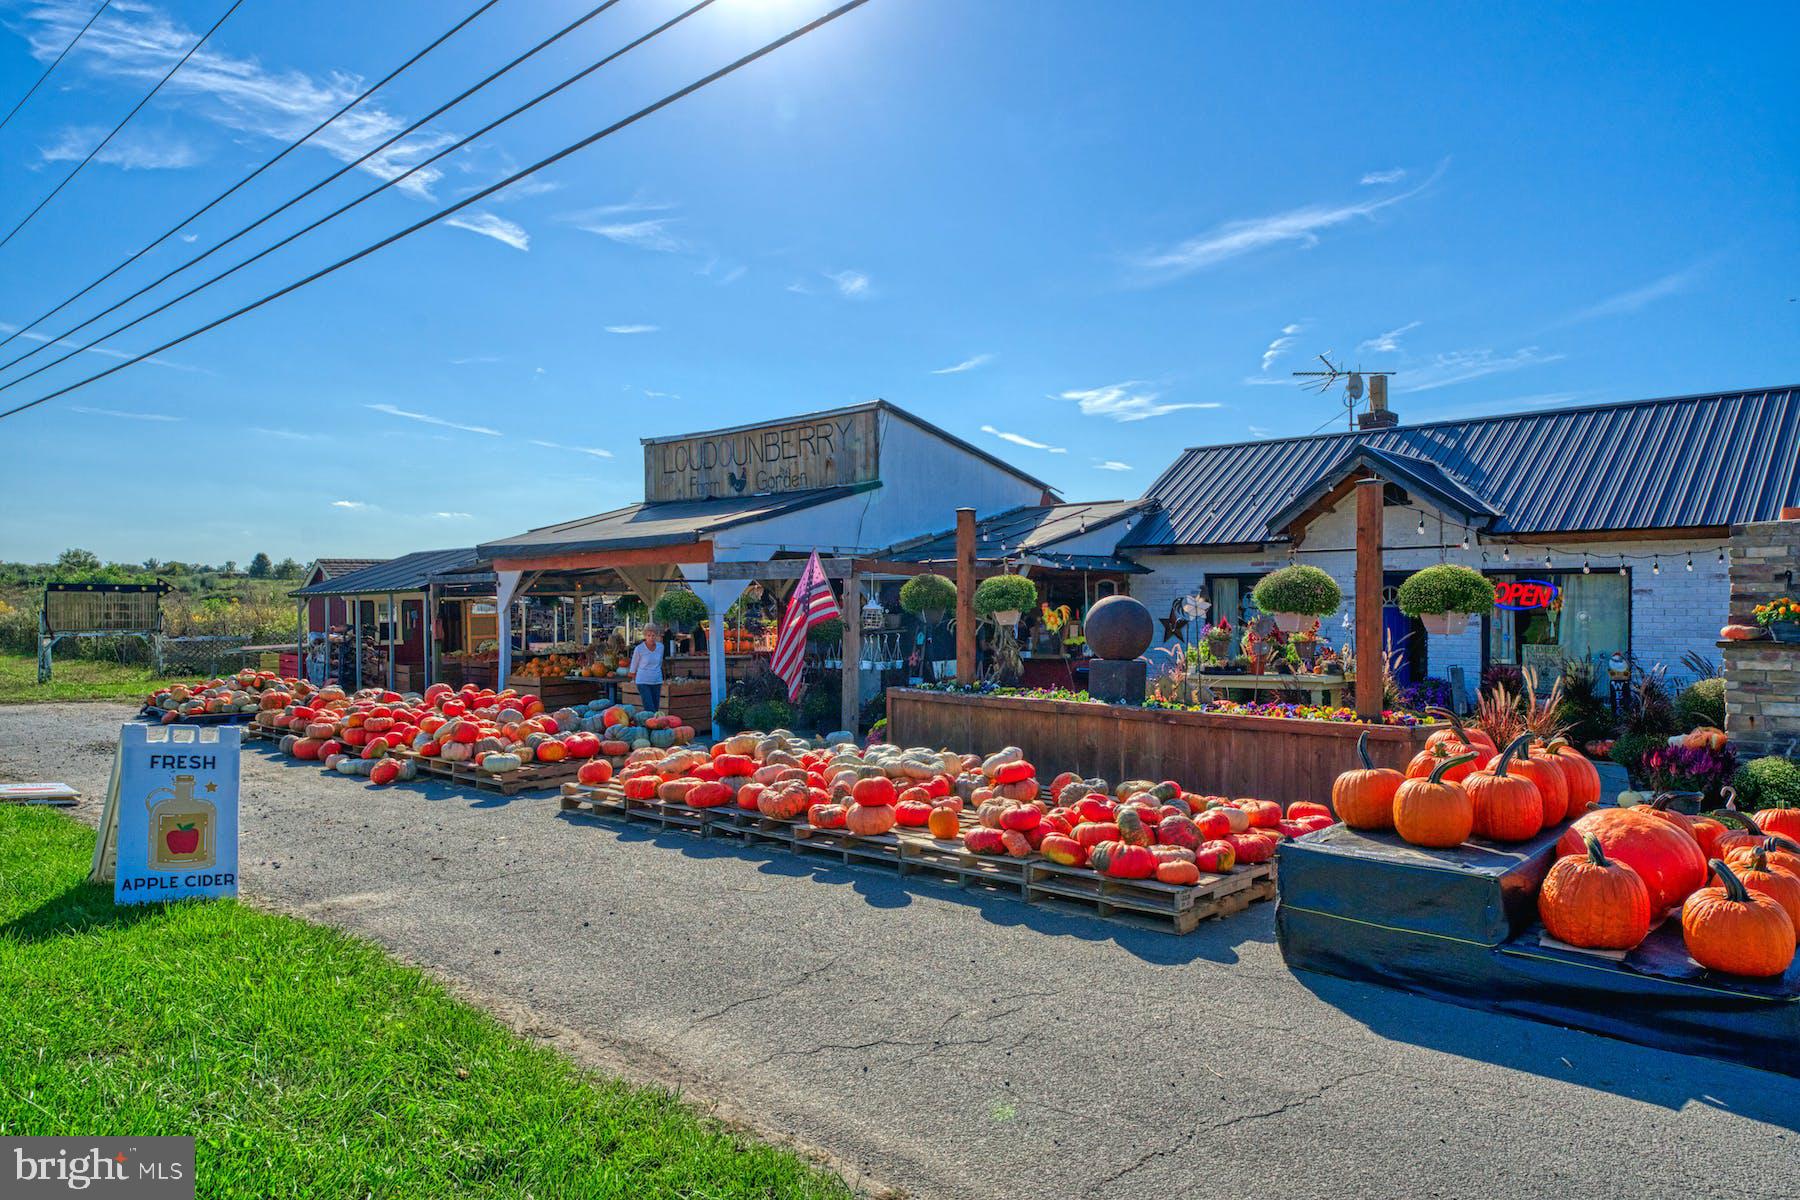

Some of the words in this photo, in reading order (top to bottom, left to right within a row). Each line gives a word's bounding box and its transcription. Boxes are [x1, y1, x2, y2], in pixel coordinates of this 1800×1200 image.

[663, 419, 853, 474] LOUDOUNBERRY
[689, 476, 720, 496] Farm
[756, 467, 808, 492] Garden
[1494, 581, 1553, 608] OPEN
[150, 755, 216, 770] FRESH
[121, 875, 179, 891] APPLE
[184, 873, 236, 888] CIDER
